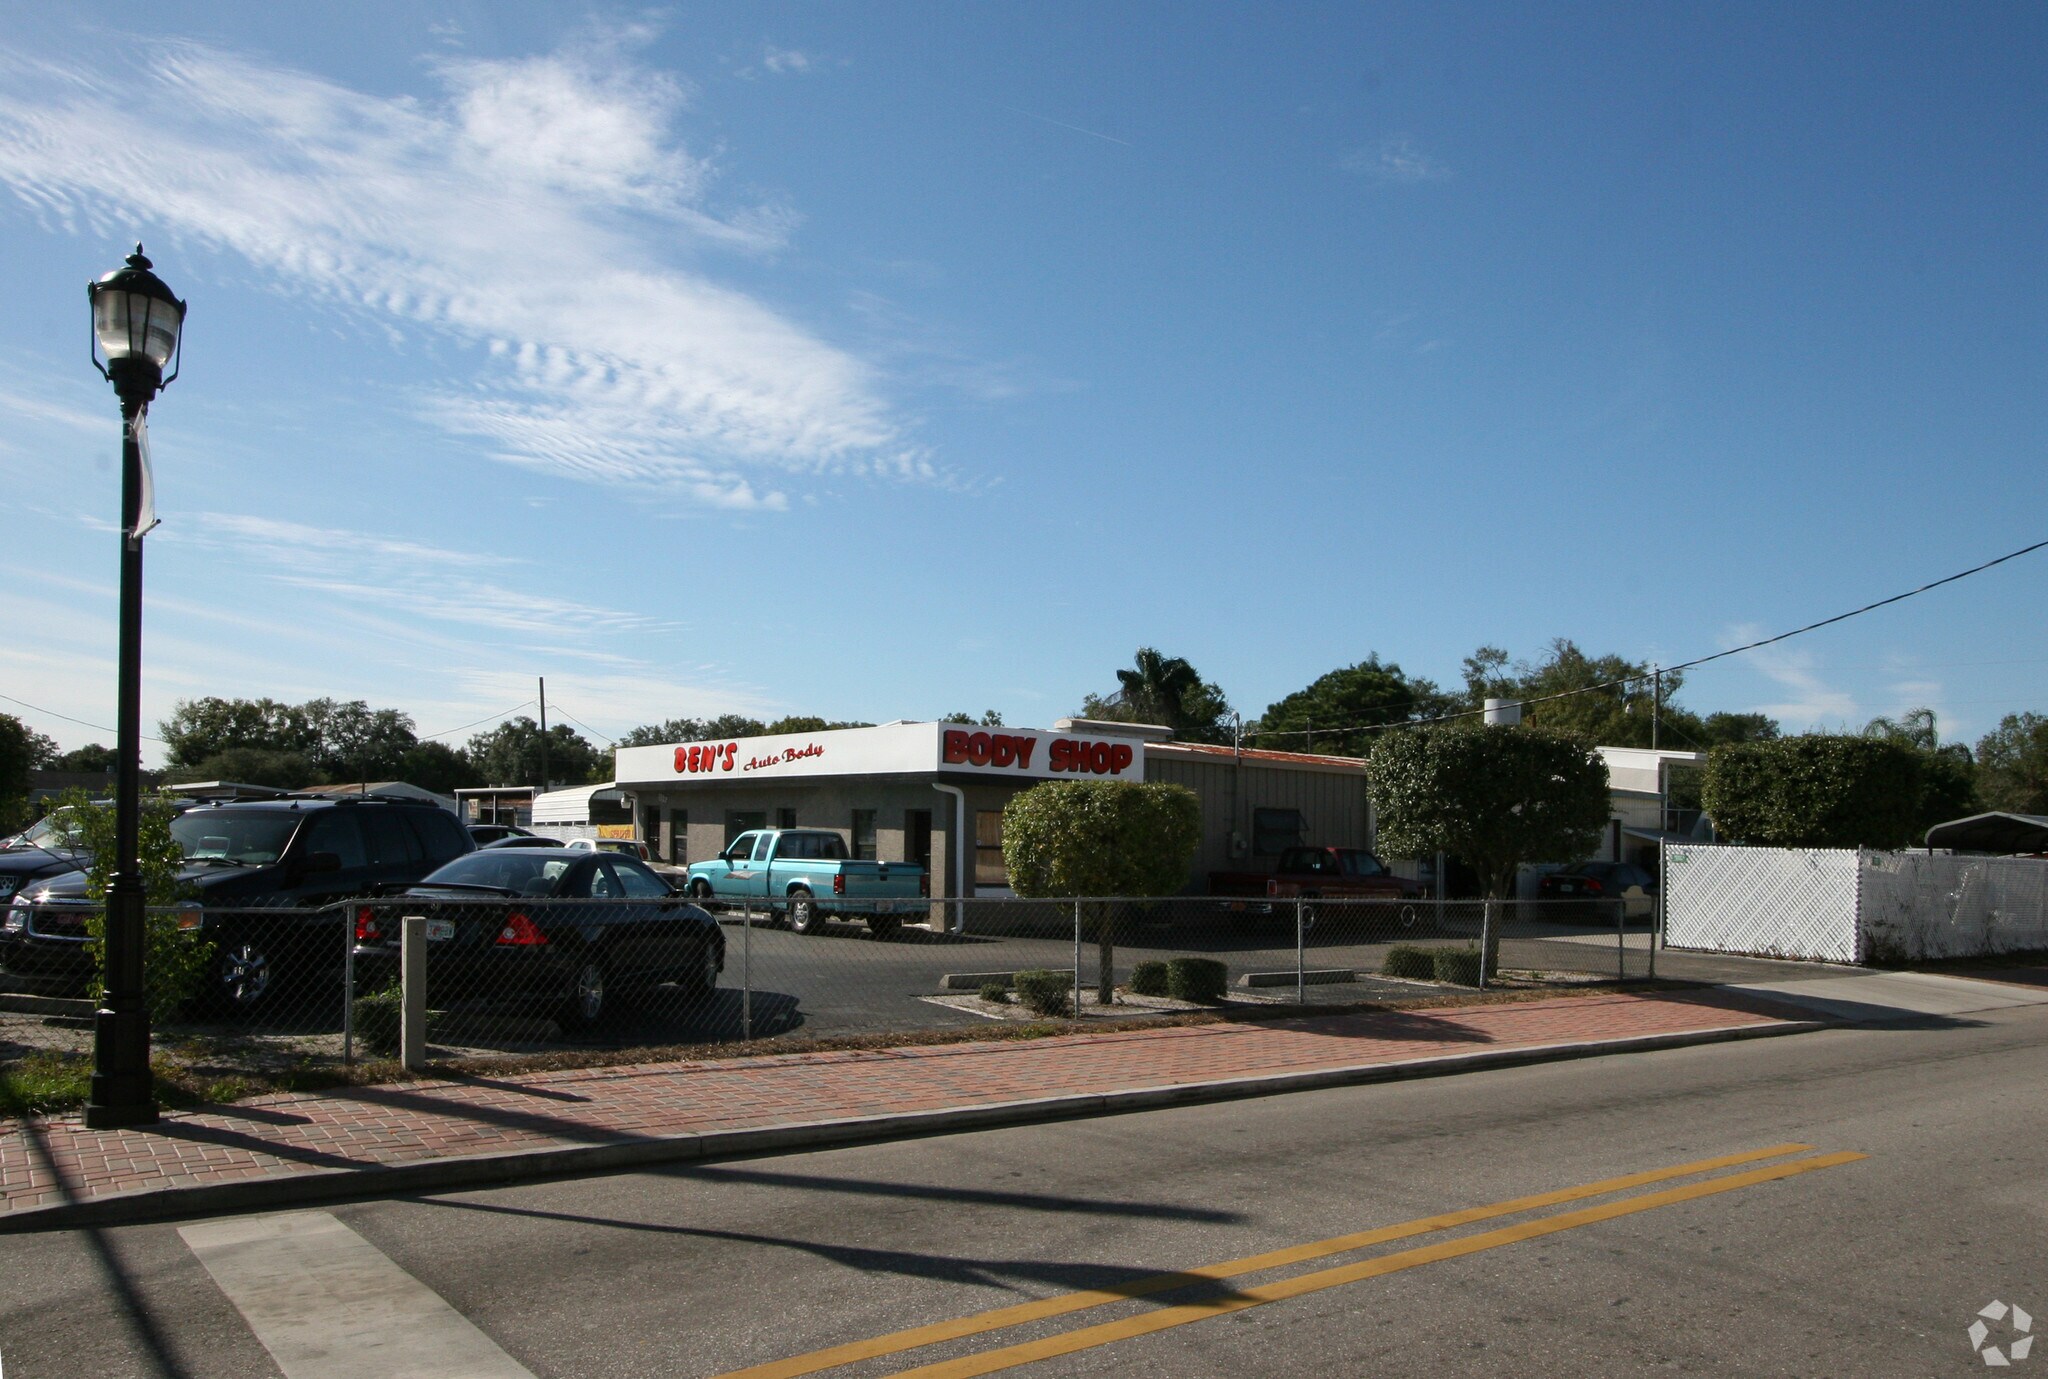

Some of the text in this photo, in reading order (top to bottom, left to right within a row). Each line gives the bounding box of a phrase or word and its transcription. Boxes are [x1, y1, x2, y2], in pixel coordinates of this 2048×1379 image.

[674, 742, 825, 773] BEN'S Auto Body
[943, 729, 1133, 775] BODY SHOP
